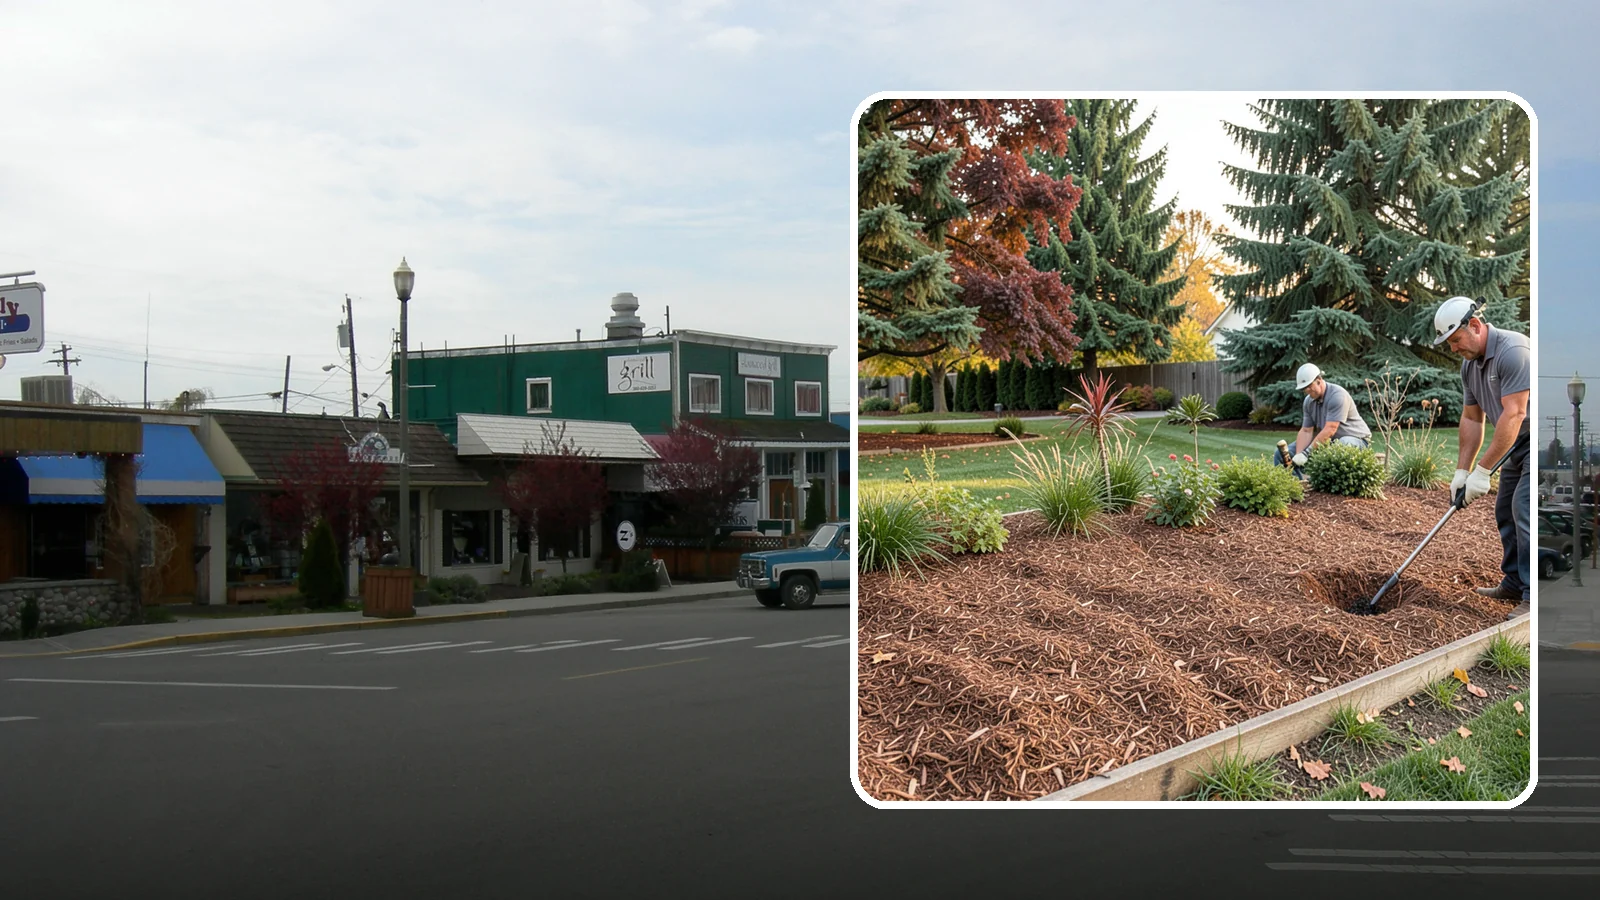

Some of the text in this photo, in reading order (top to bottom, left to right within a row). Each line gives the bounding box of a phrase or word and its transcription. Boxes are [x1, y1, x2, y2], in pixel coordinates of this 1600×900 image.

[20, 337, 38, 345] Salads
[617, 356, 655, 391] grill
[619, 529, 634, 542] Z's
